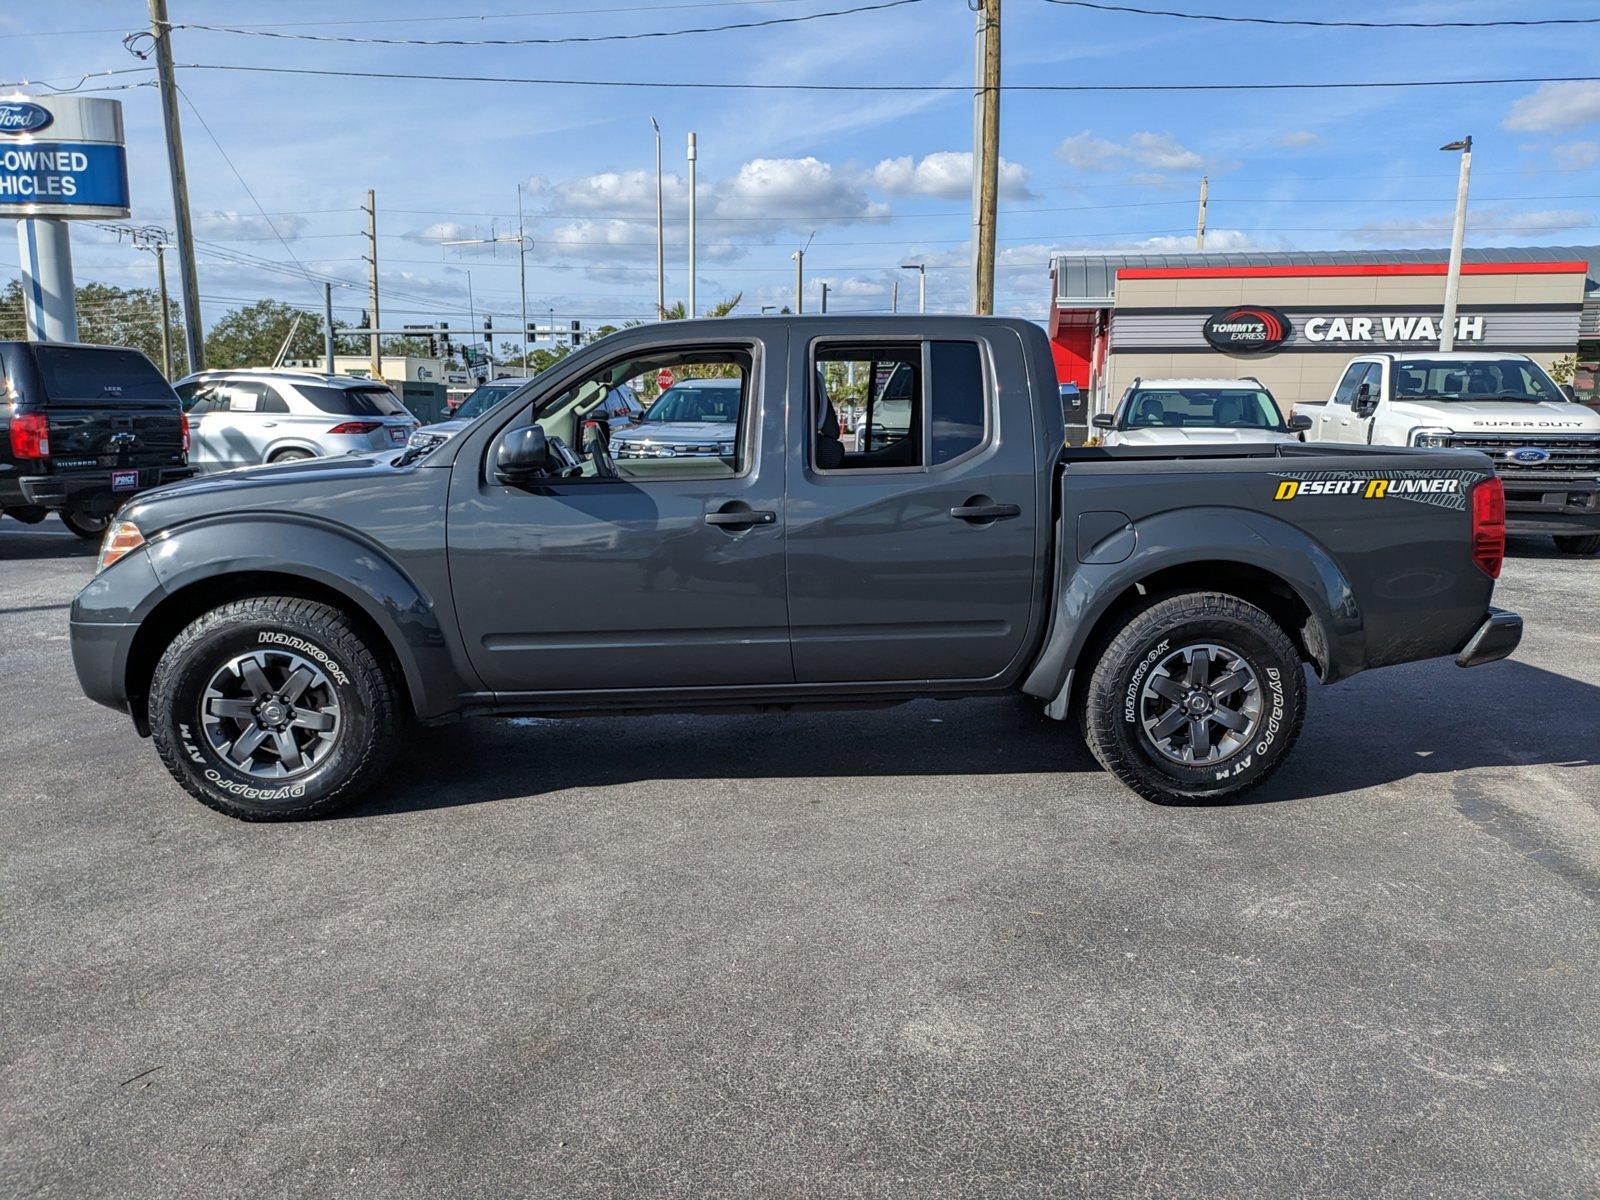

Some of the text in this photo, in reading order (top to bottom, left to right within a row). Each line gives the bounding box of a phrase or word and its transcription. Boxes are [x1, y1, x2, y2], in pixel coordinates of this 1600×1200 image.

[0, 105, 34, 126] Ford
[1212, 323, 1265, 333] TOMMY'S
[1304, 317, 1373, 341] CAR
[1230, 332, 1267, 340] EXPRESS
[658, 375, 673, 385] STOP
[1519, 451, 1540, 460] Ford
[1274, 479, 1460, 500] DESERT RUNNER
